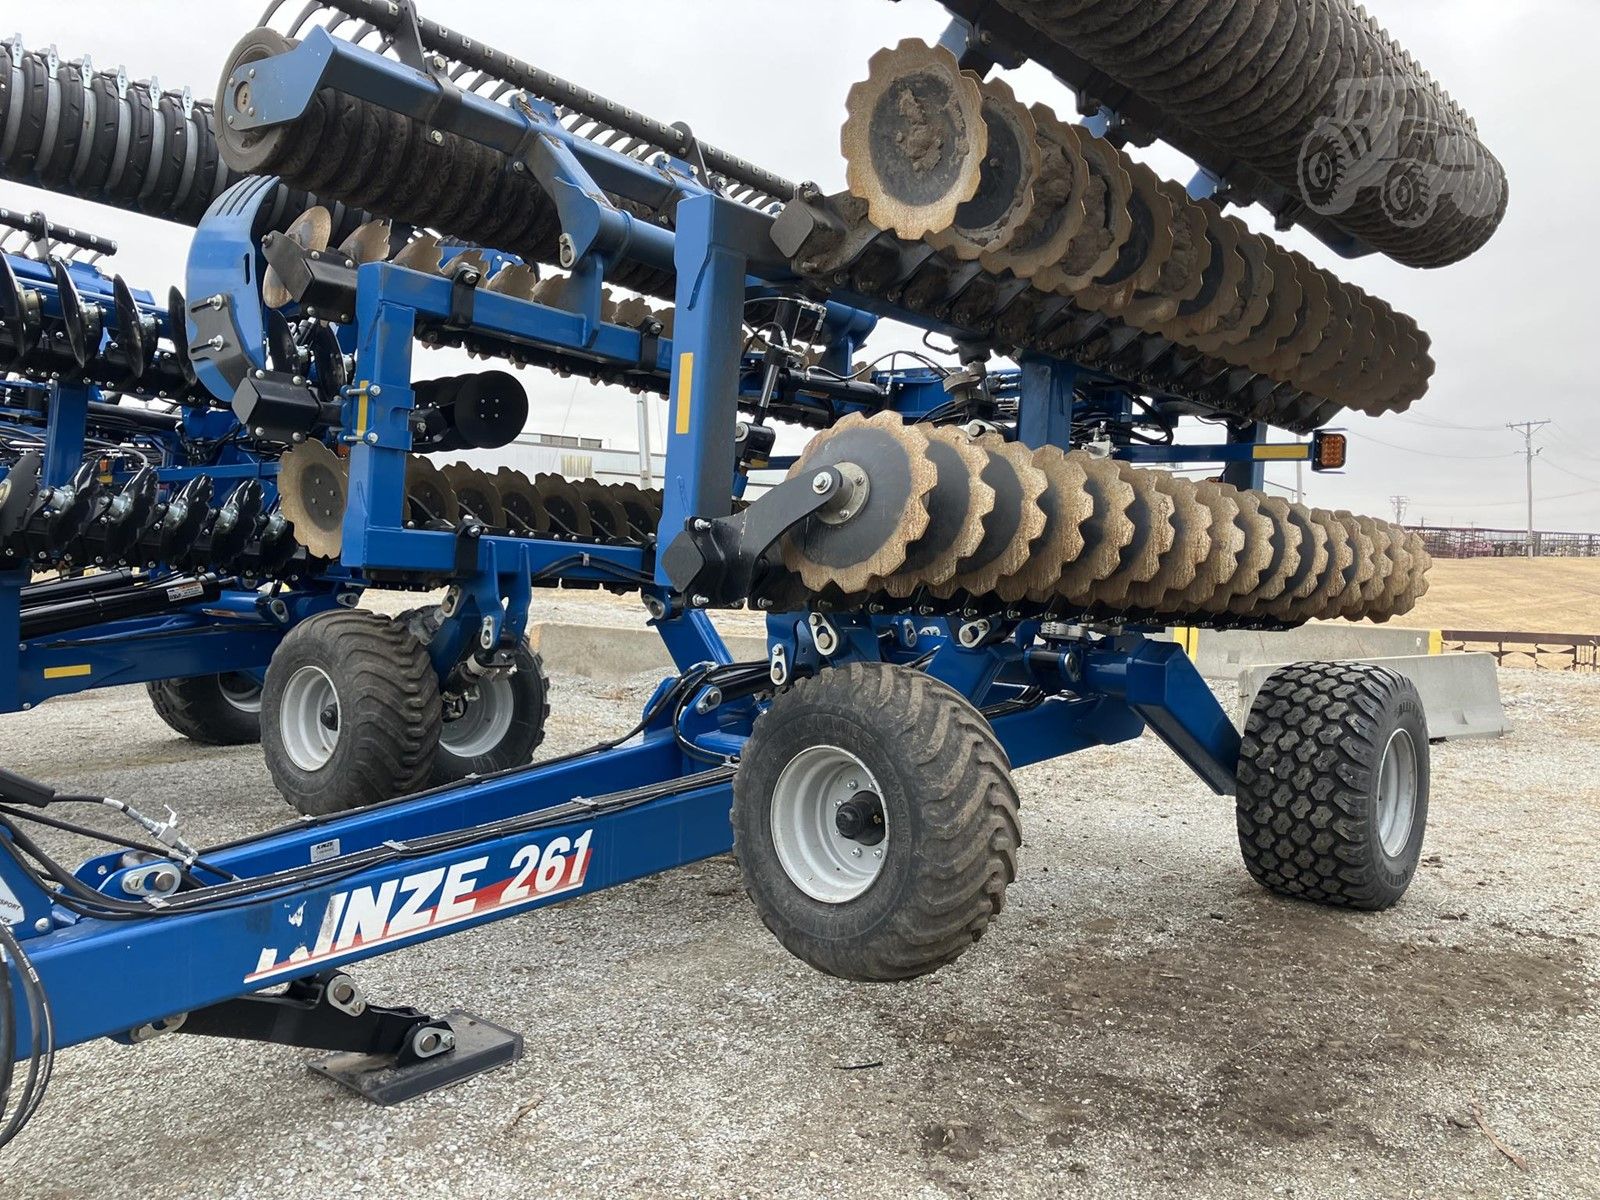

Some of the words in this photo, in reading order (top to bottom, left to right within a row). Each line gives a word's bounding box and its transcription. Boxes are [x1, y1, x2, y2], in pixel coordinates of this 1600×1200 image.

[0, 898, 21, 911] SPORT
[254, 856, 490, 974] INZE
[499, 828, 593, 904] 261
